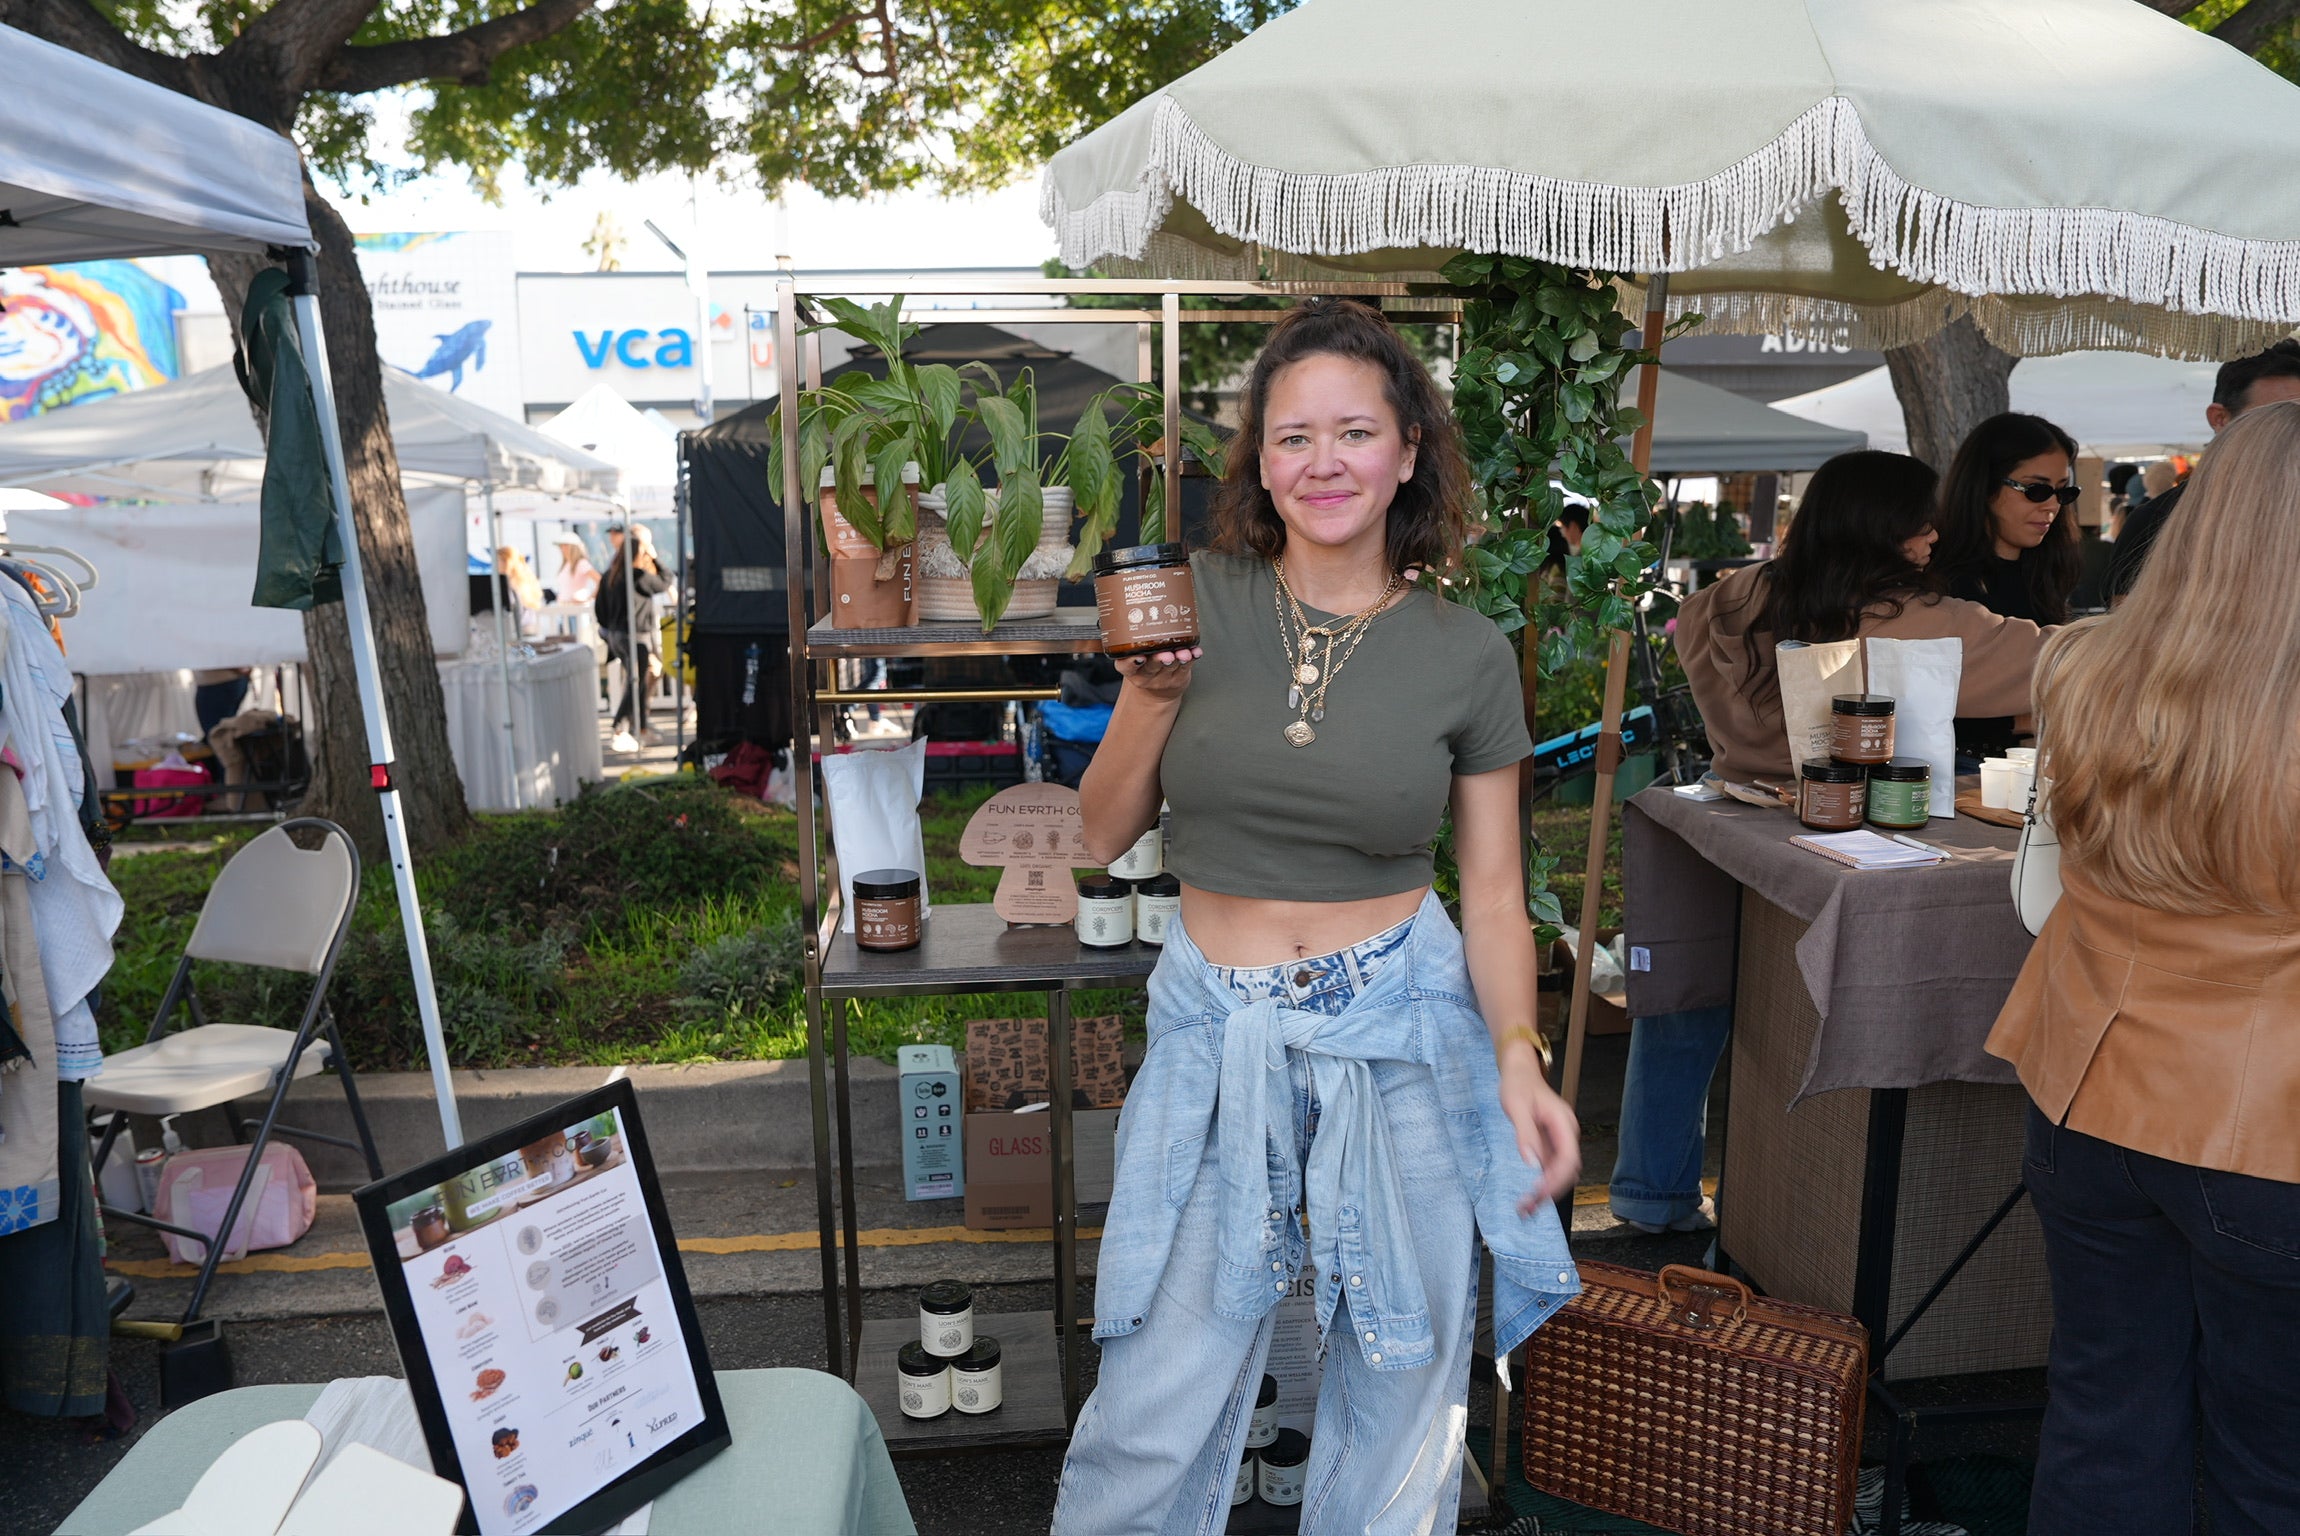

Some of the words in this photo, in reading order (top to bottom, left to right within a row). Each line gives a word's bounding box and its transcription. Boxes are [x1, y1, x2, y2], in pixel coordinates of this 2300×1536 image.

[572, 327, 693, 370] vca
[903, 563, 912, 602] FUN
[1124, 581, 1166, 592] MUSHROOM
[1125, 591, 1153, 599] MOCHA
[988, 804, 1015, 815] FUN
[1147, 903, 1179, 911] CORDYCEPS
[989, 1136, 1042, 1156] GLASS
[479, 1155, 548, 1191] EART
[481, 1196, 501, 1209] MAKE
[501, 1185, 527, 1201] COFFEE
[526, 1174, 551, 1191] BETTER
